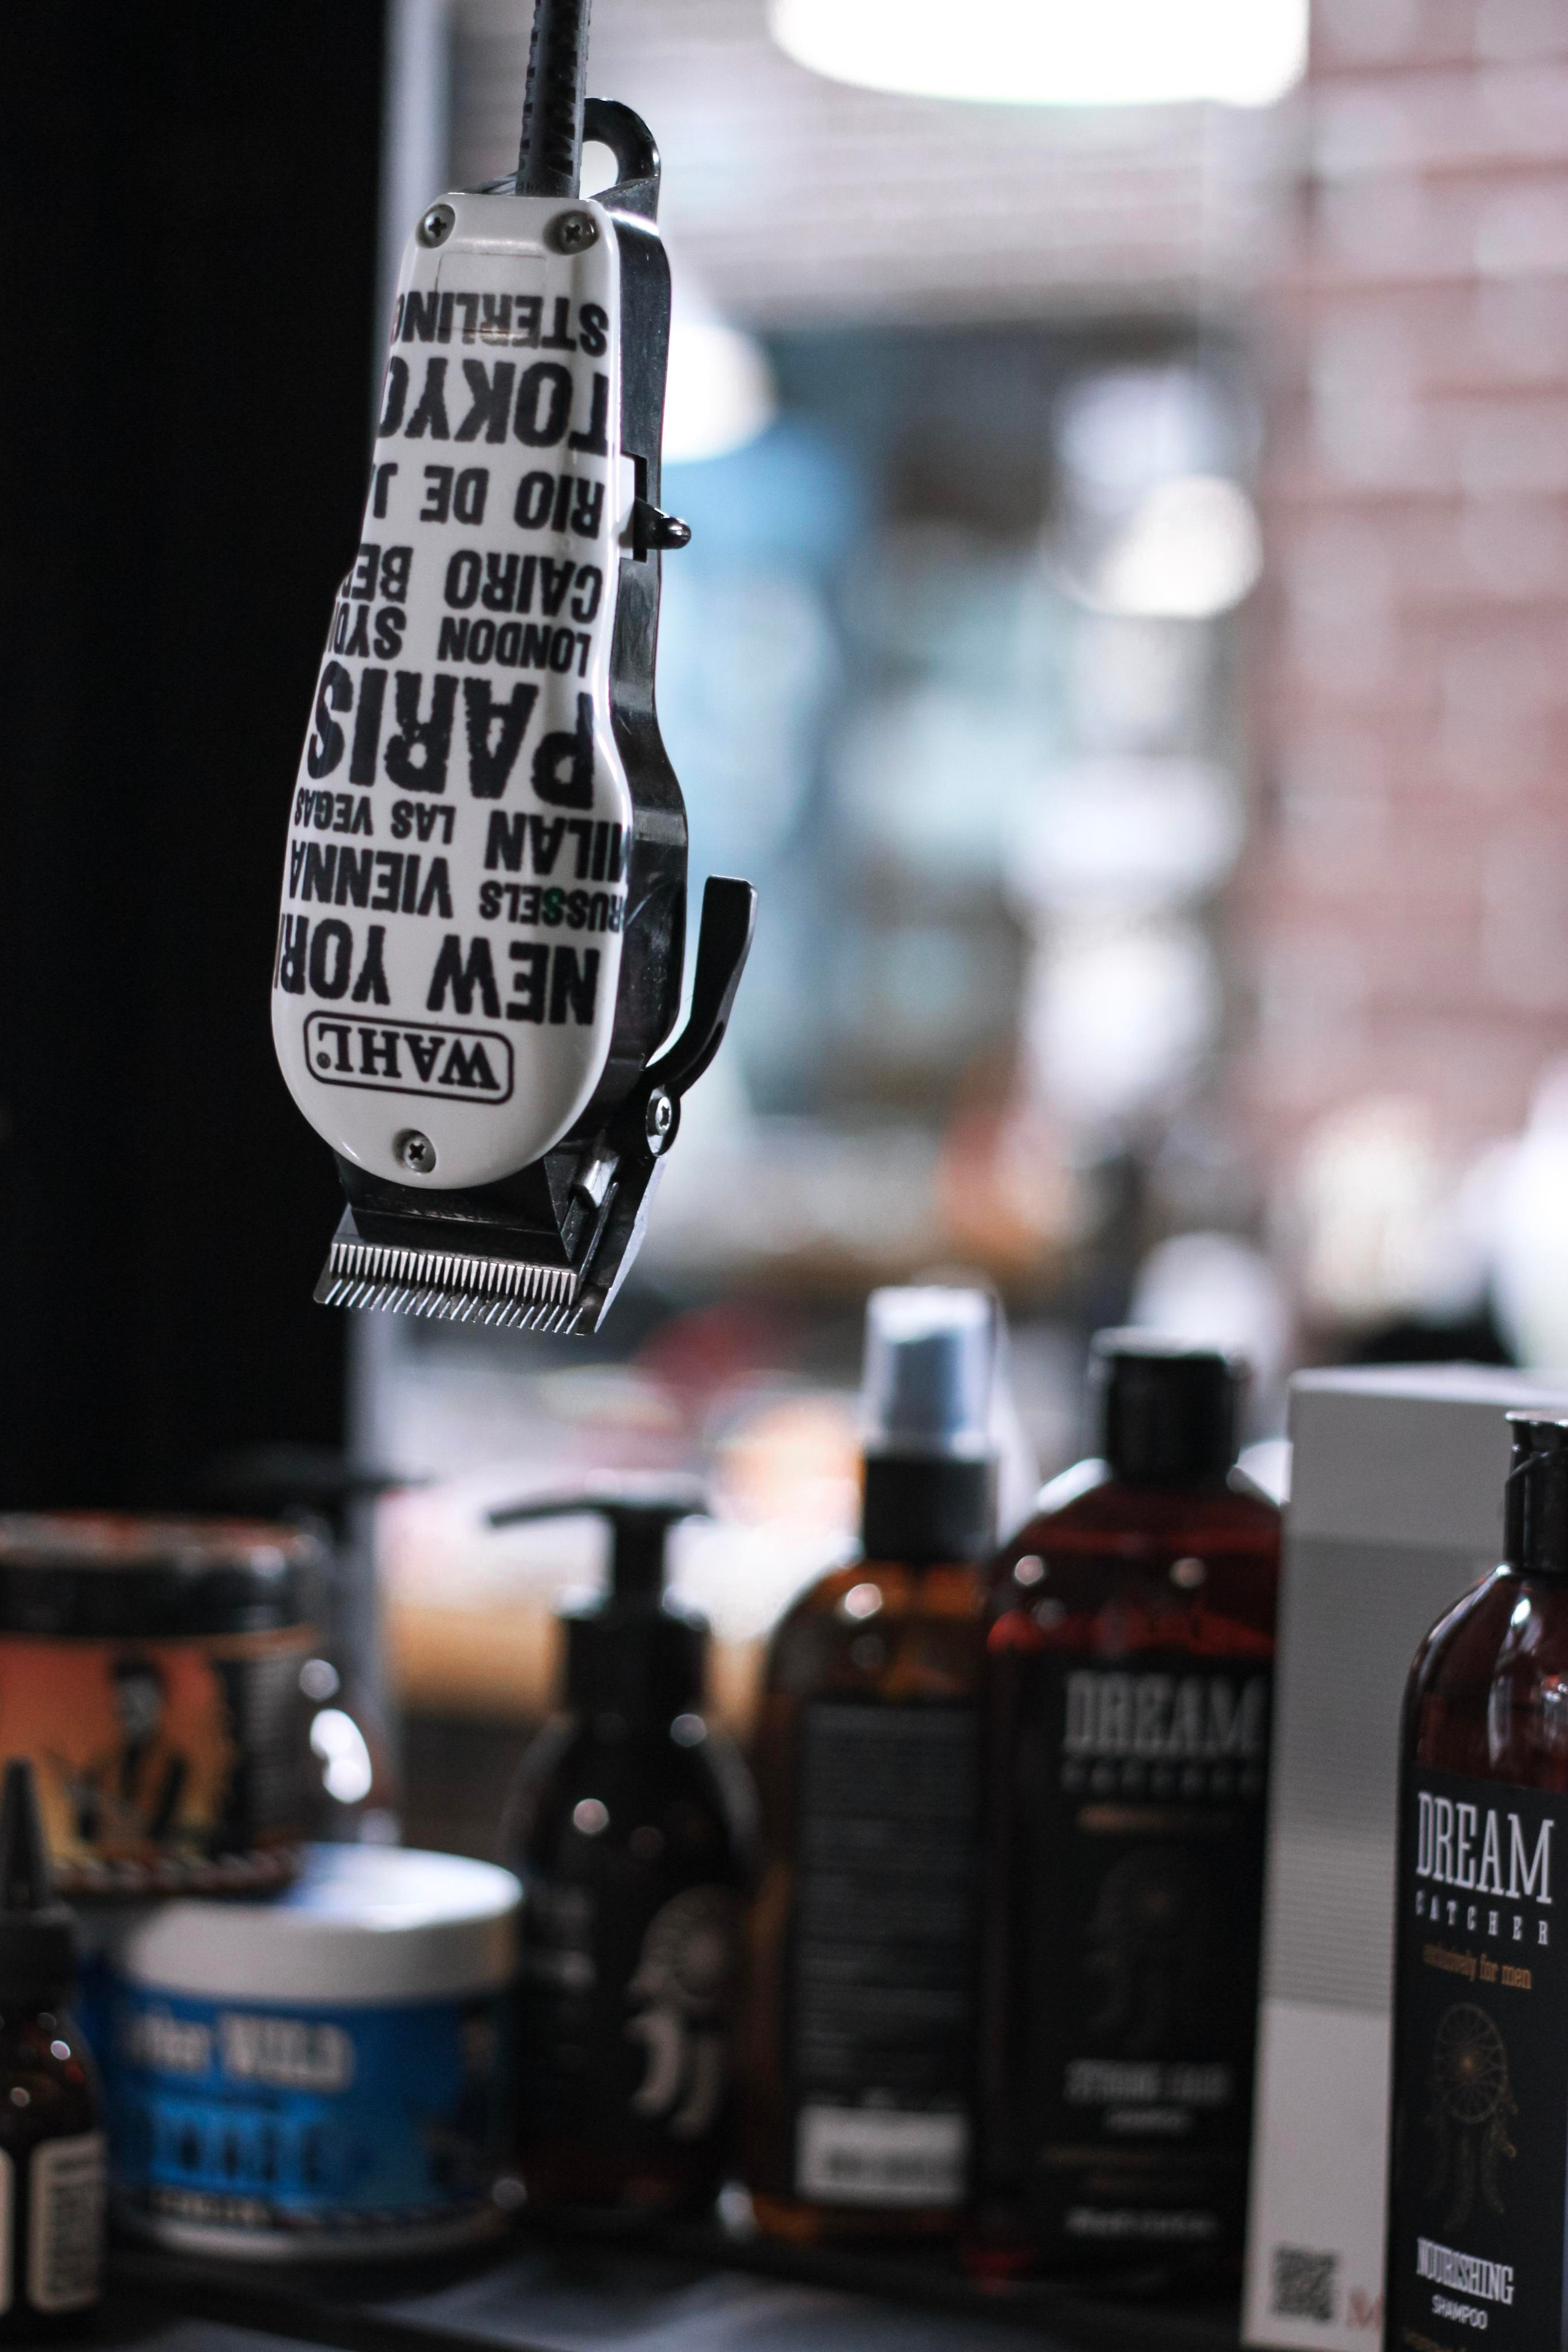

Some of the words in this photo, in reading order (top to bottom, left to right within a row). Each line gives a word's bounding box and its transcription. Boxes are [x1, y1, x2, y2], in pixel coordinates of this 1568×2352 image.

[420, 465, 489, 526] DE
[513, 470, 605, 540] RIO
[443, 549, 603, 624] CAIRO
[327, 601, 407, 660] SYD
[437, 616, 592, 678] LONDON
[307, 660, 594, 810] PARIS
[294, 786, 374, 835] VEGAS
[390, 799, 456, 845] LAS
[289, 839, 453, 919] VIENNA
[478, 879, 625, 933] RUSSELS
[273, 913, 391, 1006] YOR
[426, 933, 601, 1026] NEW
[1415, 1790, 1555, 1905] DREAM
[1501, 1965, 1532, 1990] men
